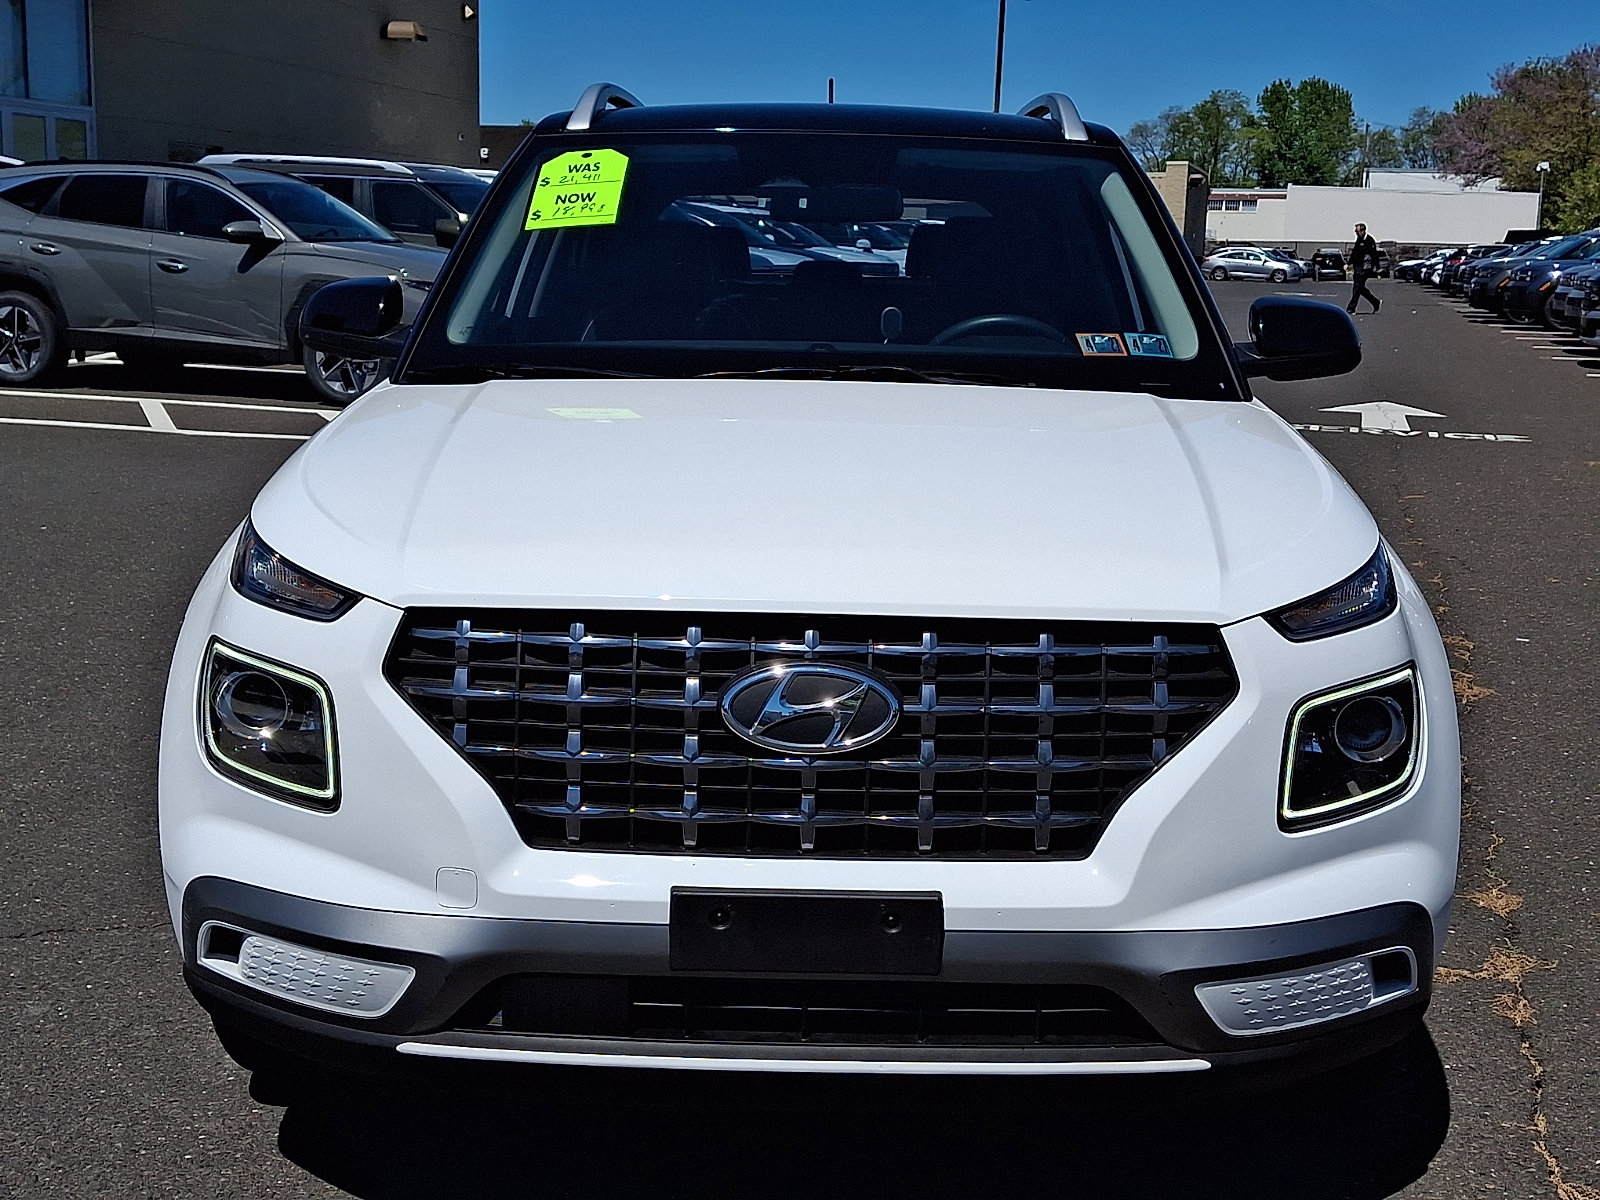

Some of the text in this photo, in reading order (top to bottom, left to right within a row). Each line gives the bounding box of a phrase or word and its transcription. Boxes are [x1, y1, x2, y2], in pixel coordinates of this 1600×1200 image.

[568, 161, 601, 173] WAS
[539, 177, 551, 187] $
[554, 192, 597, 205] NOW
[530, 210, 542, 221] $
